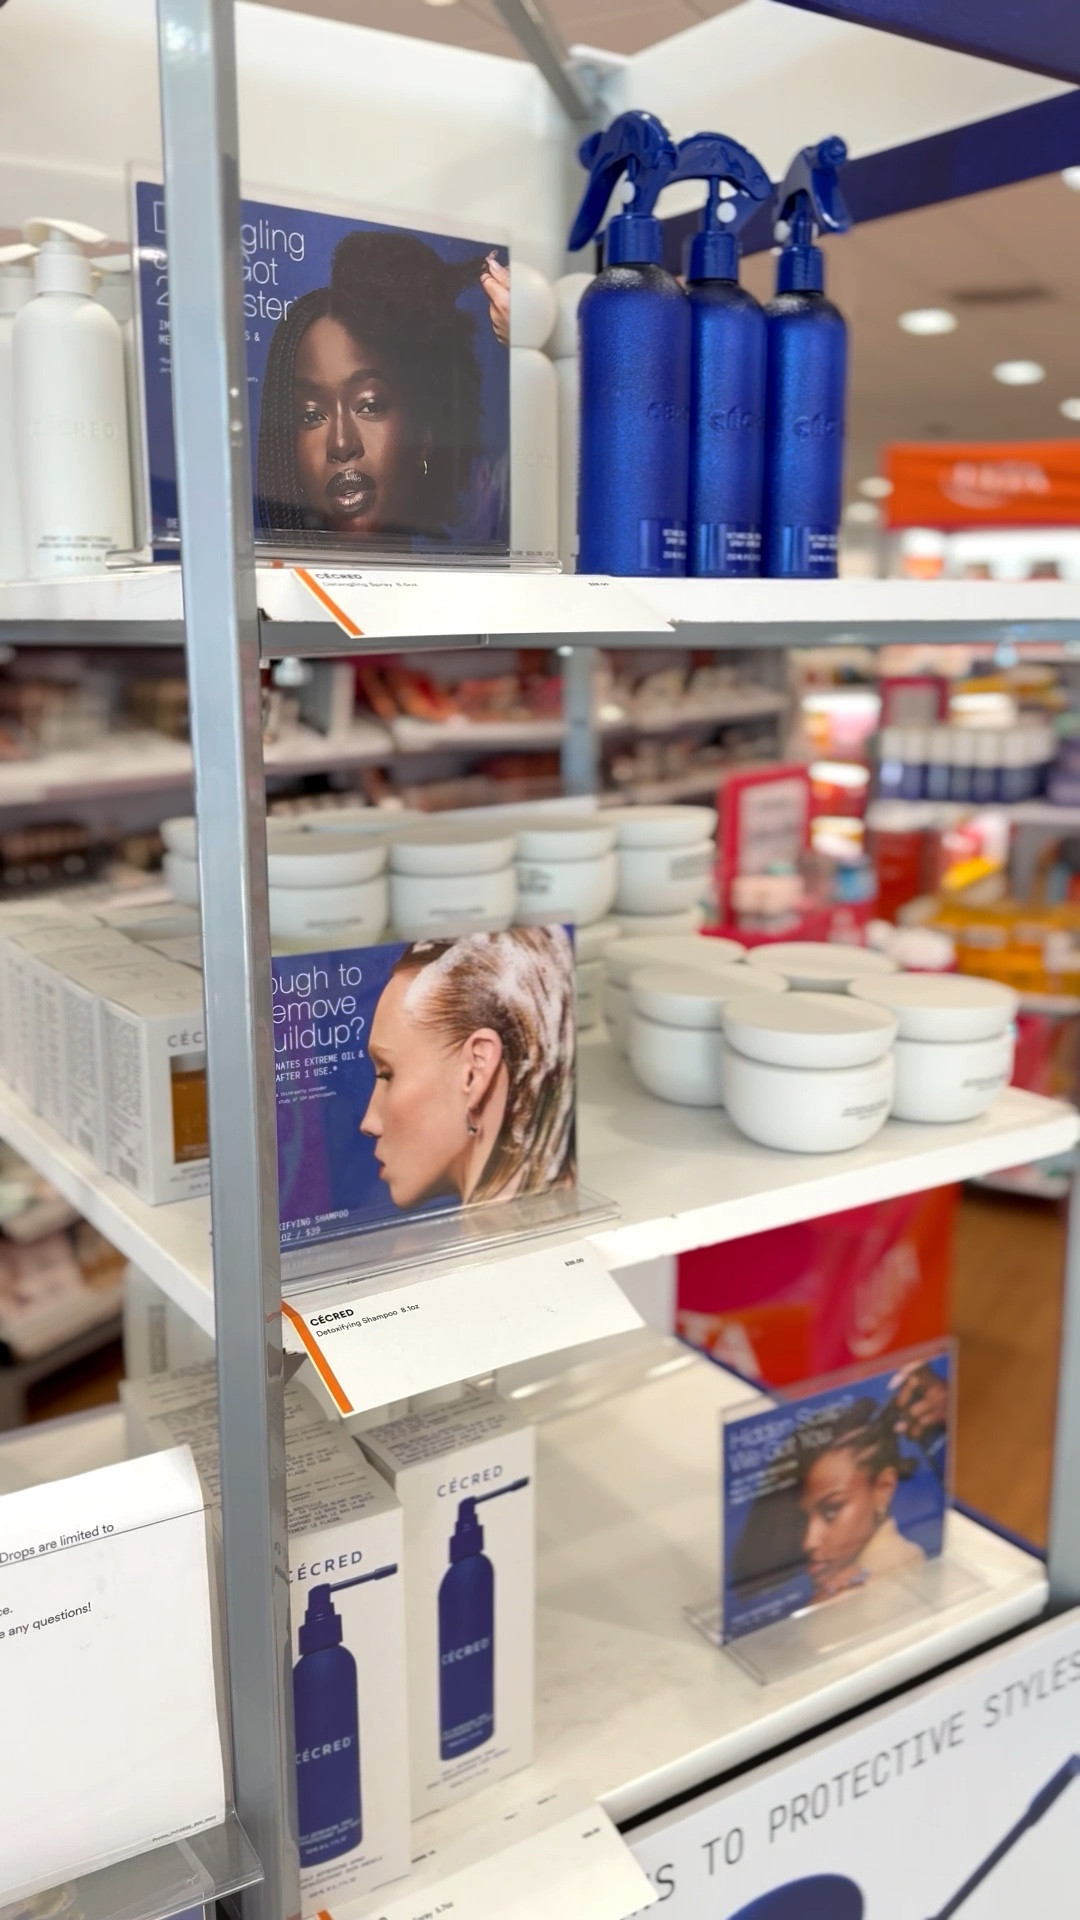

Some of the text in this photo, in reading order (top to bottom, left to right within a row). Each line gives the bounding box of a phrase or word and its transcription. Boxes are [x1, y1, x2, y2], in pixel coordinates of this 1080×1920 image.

[338, 963, 362, 987] to
[304, 1053, 339, 1067] EXTREME
[341, 1051, 356, 1062] OIL
[358, 1050, 365, 1058] &
[275, 1070, 301, 1083] AFTER
[305, 1069, 310, 1078] 1
[314, 1209, 349, 1224] SHAMPOO
[310, 1308, 355, 1327] CÉCRED
[316, 1304, 420, 1337] Detoxifying Shampoo 8.1oz
[437, 1465, 504, 1498] CÉCRED
[0, 1523, 115, 1563] Drops are limited to
[8, 1623, 30, 1637] any
[32, 1601, 92, 1630] questions!
[441, 1636, 490, 1665] CÉCRED
[295, 1736, 352, 1765] CÉCRED
[701, 1827, 744, 1876] TO
[769, 1711, 966, 1844] PROTECTIVE
